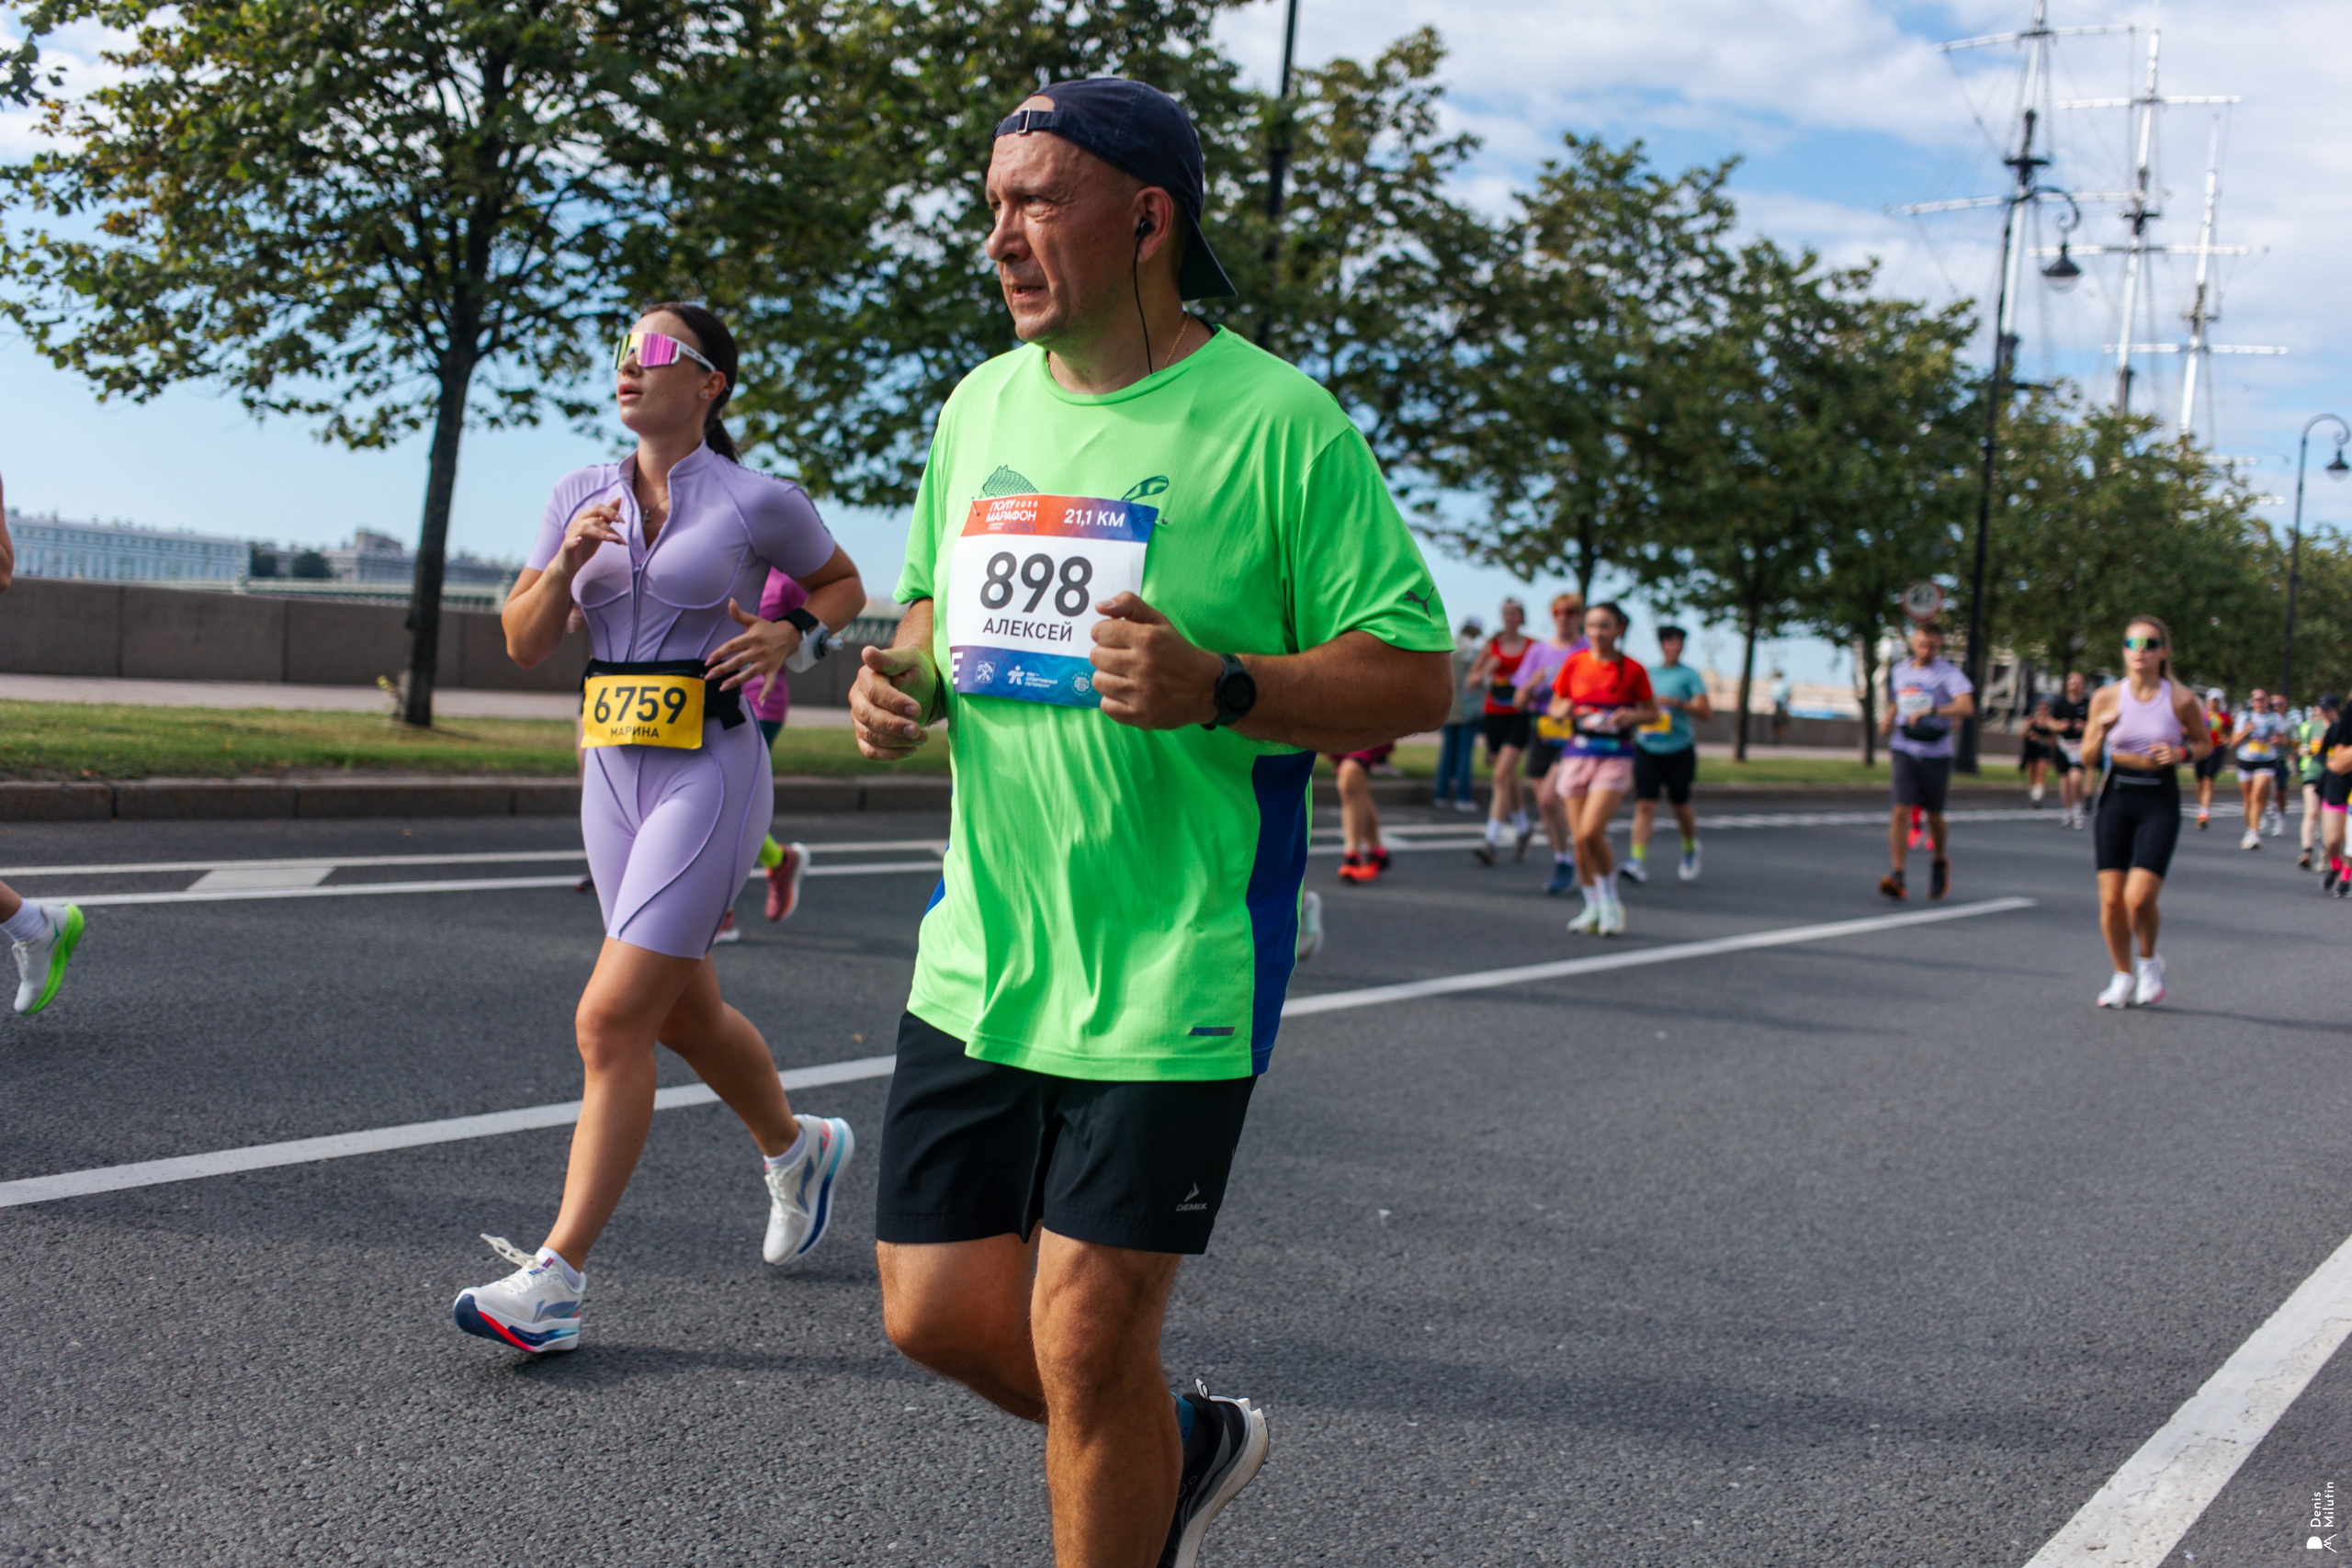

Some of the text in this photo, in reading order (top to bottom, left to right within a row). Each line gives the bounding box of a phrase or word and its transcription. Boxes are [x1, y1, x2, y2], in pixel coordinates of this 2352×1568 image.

[989, 500, 1015, 512] ПОЛУ
[986, 510, 1037, 523] МАРАФОН
[1064, 508, 1125, 527] 21,1 КМ
[980, 551, 1092, 617] 898
[982, 617, 1073, 642] АЛЕКСЕЙ
[594, 686, 687, 724] 6759
[610, 727, 659, 739] МАРИНА
[1175, 1202, 1207, 1212] DEMIX
